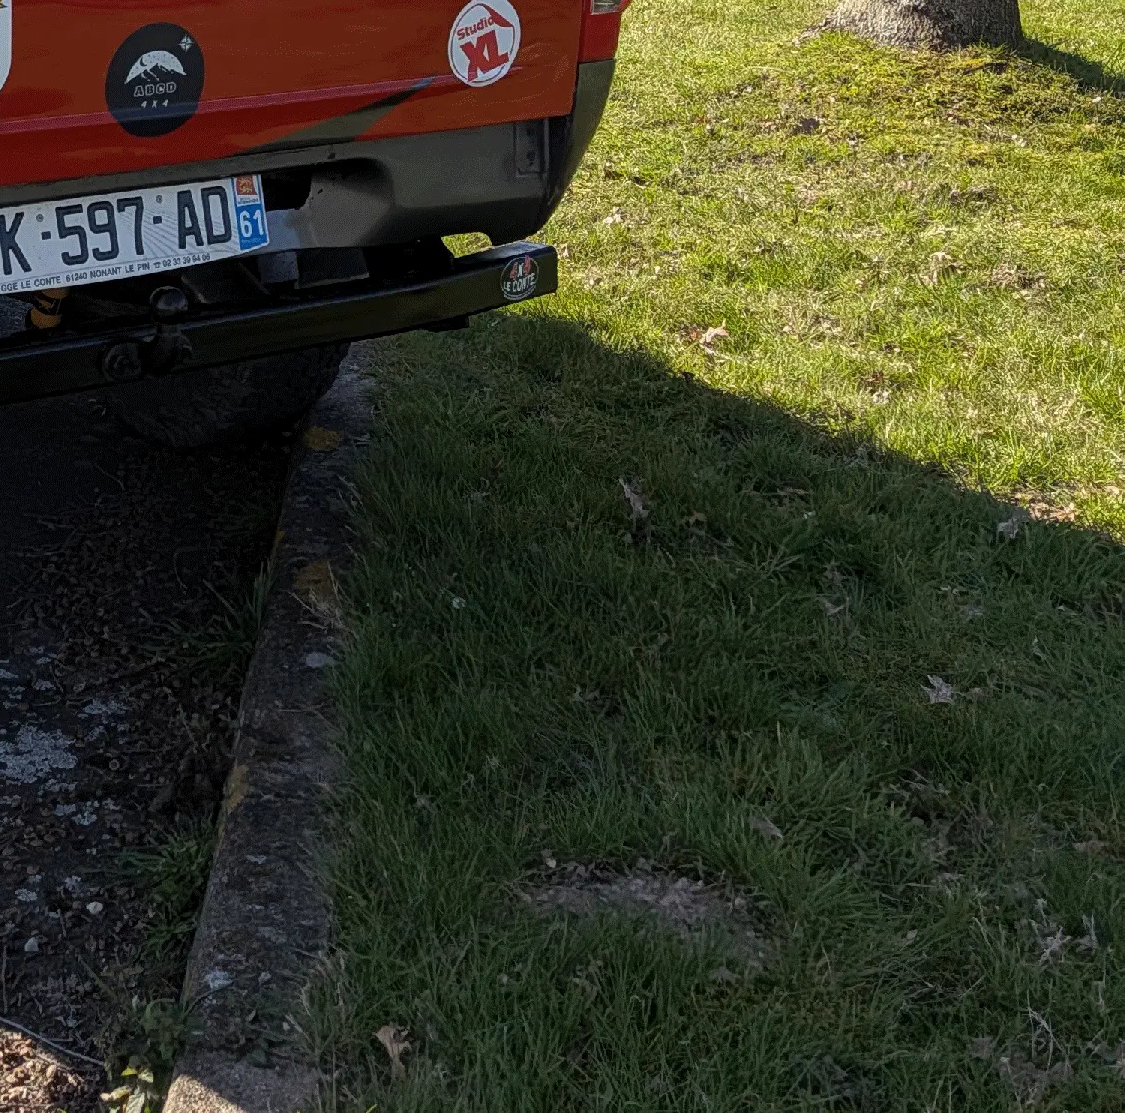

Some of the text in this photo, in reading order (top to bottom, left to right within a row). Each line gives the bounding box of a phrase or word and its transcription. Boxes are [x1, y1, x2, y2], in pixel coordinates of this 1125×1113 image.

[457, 16, 495, 40] Studio
[459, 29, 510, 82] XL
[133, 81, 177, 97] ABCD
[239, 209, 264, 237] 61
[20, 282, 31, 290] LE
[33, 276, 61, 288] CONTE
[66, 272, 88, 282] 61240
[90, 266, 122, 279] NONANT
[125, 263, 135, 273] LE
[504, 273, 535, 292] LE CONTE
